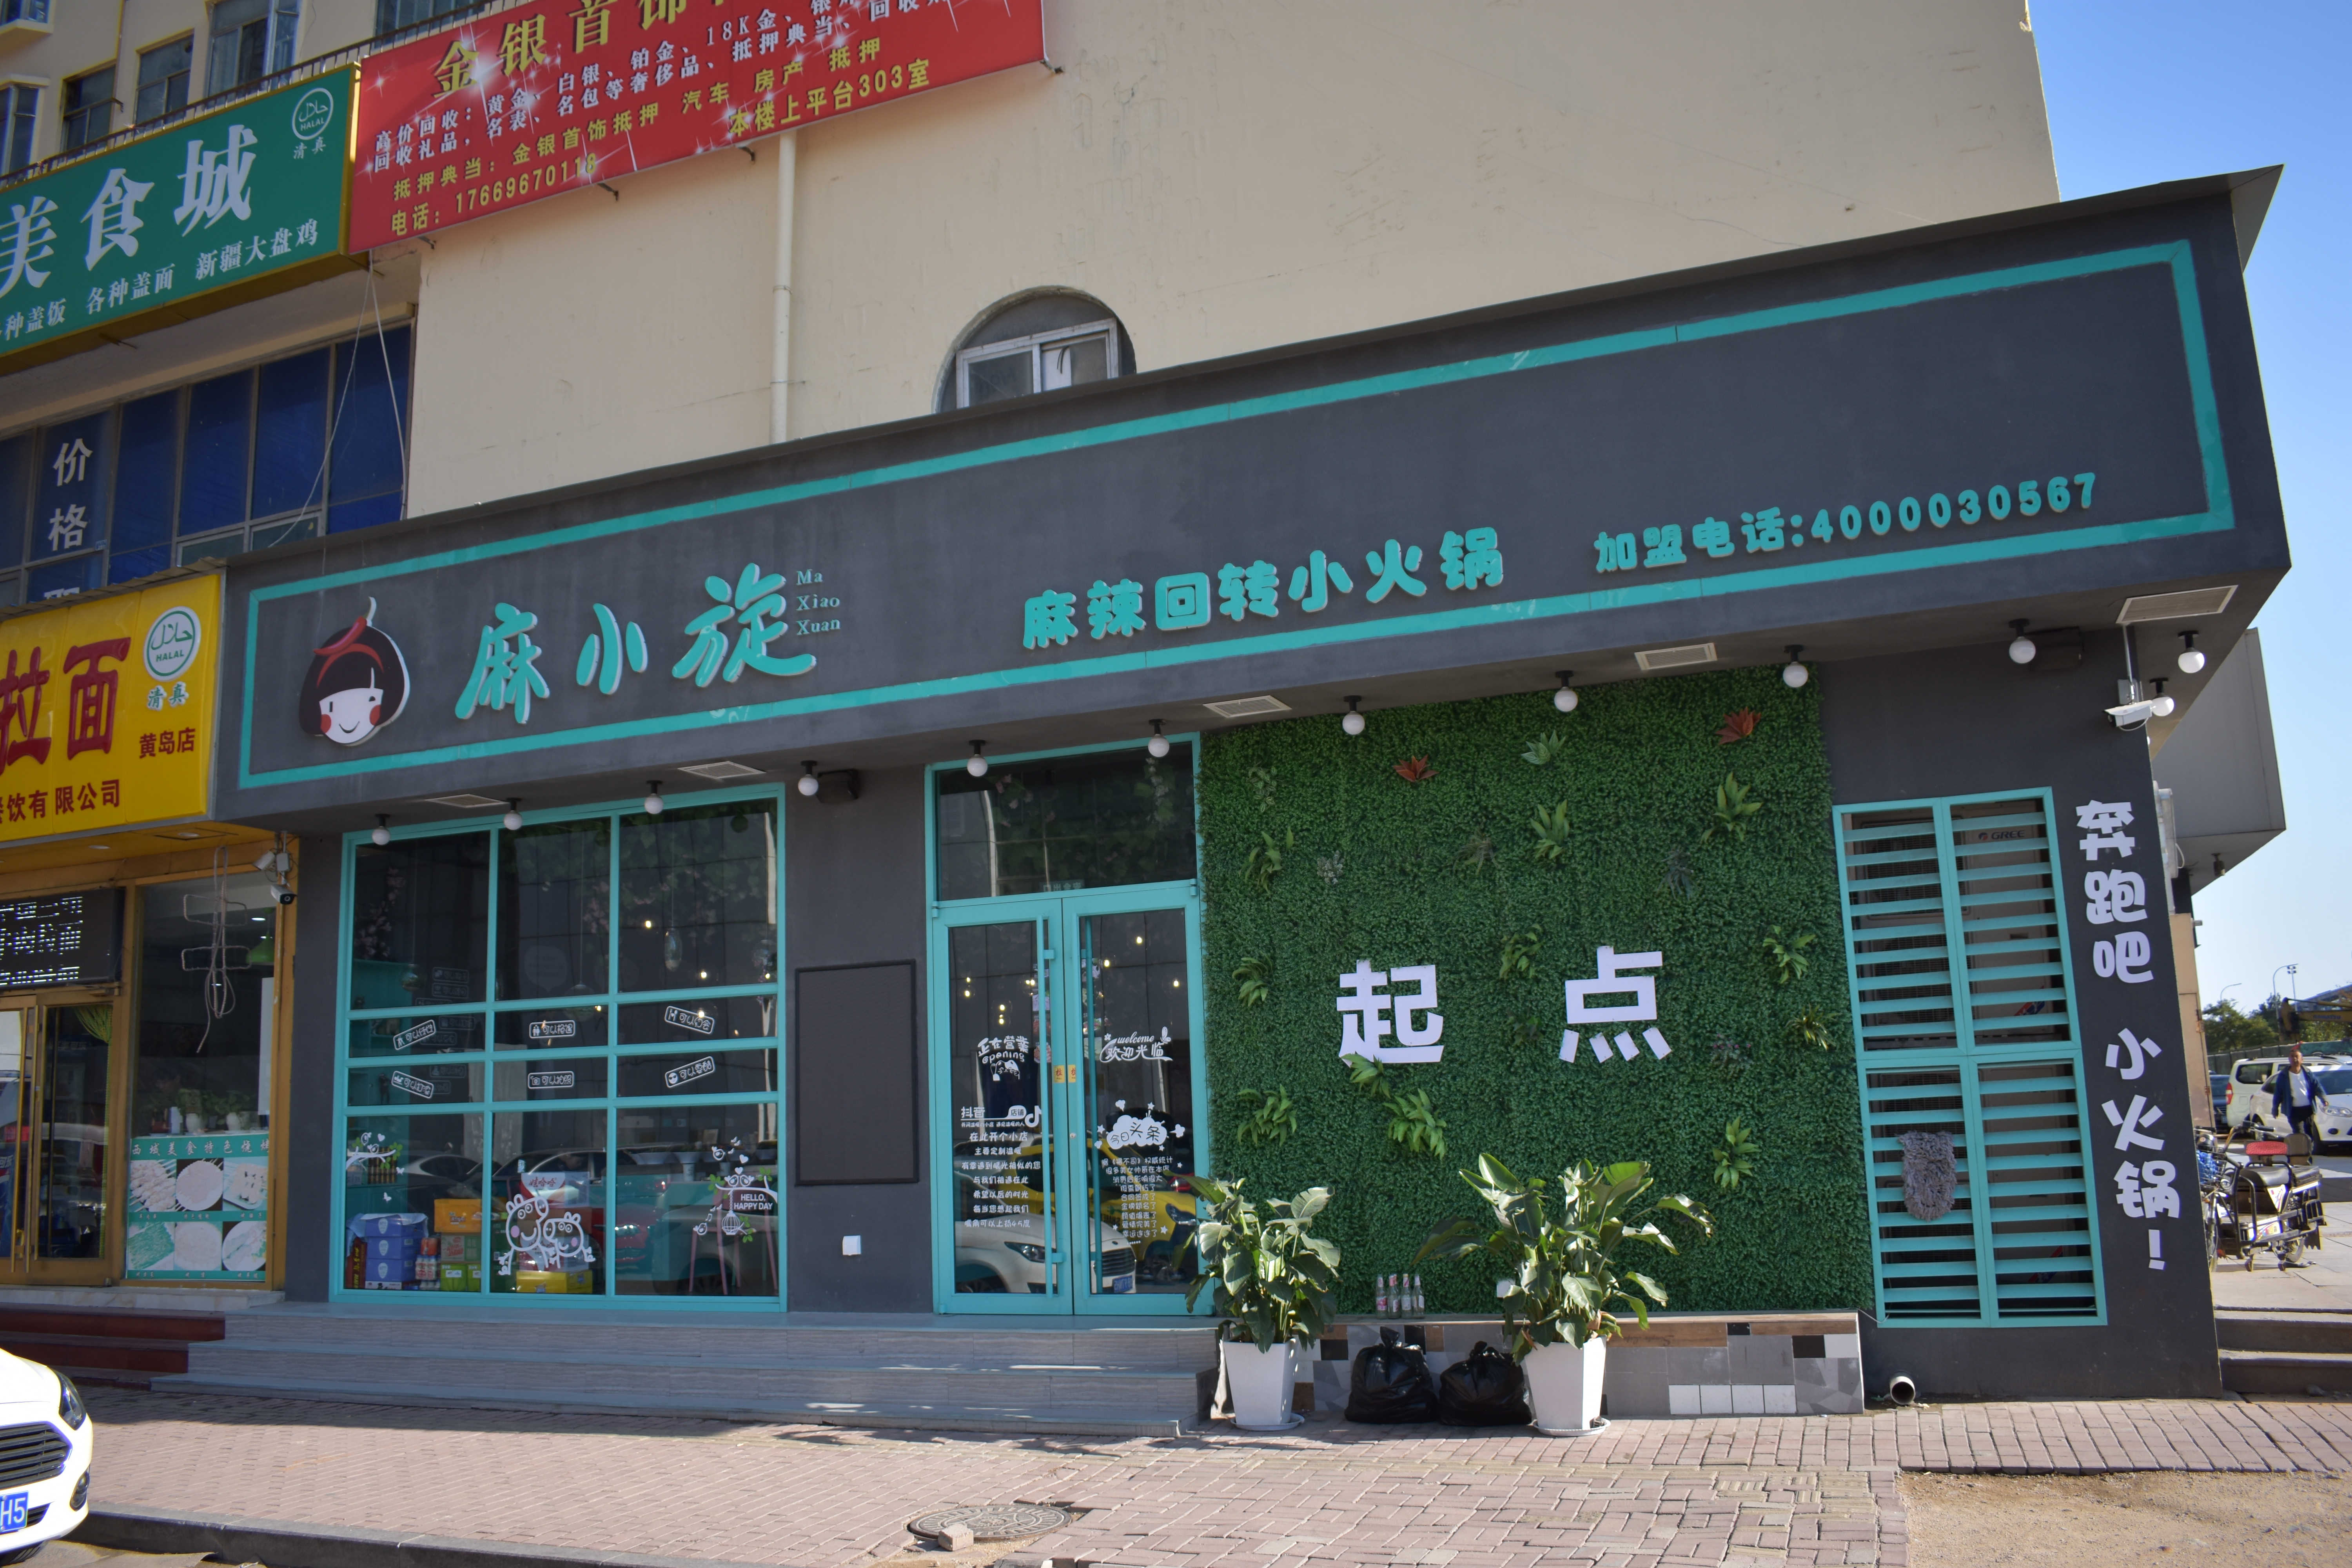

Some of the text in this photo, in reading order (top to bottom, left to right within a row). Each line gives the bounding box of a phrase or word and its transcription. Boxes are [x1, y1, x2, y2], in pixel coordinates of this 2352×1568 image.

[300, 117, 325, 131] HALAL
[293, 137, 326, 160] 清真
[0, 124, 258, 298] 美食城
[0, 218, 318, 341] 种盖饭 各种盖面 新疆大盘鸡
[796, 569, 823, 585] Ma
[1023, 526, 1503, 649] 麻辣回转小火锅
[796, 594, 840, 610] Xiao
[796, 619, 841, 635] Xuan
[454, 563, 817, 724] 麻小旋
[156, 649, 184, 662] HALAL
[147, 682, 189, 710] 清真
[139, 727, 196, 759] 黄岛店
[0, 779, 120, 823] 饮有限公司
[1992, 829, 2025, 840] GREE
[1116, 1031, 1154, 1044] welcome
[1102, 1041, 1168, 1062] 欢迎光临
[541, 1074, 572, 1085] 可以拍照
[961, 1106, 1024, 1118] 抖音 店铺
[969, 1131, 1028, 1142] 在此开个小店
[1110, 1121, 1160, 1144] 今日头条
[974, 1147, 1022, 1156] 主要定制温暖
[962, 1161, 1041, 1170] 有幸遇到眼光相似的您
[529, 1176, 556, 1187] 娃哈哈
[973, 1175, 1029, 1184] 与我们相遇在此
[973, 1190, 1029, 1199] 希望以后的时光
[973, 1204, 1029, 1213] 每当您想起我们
